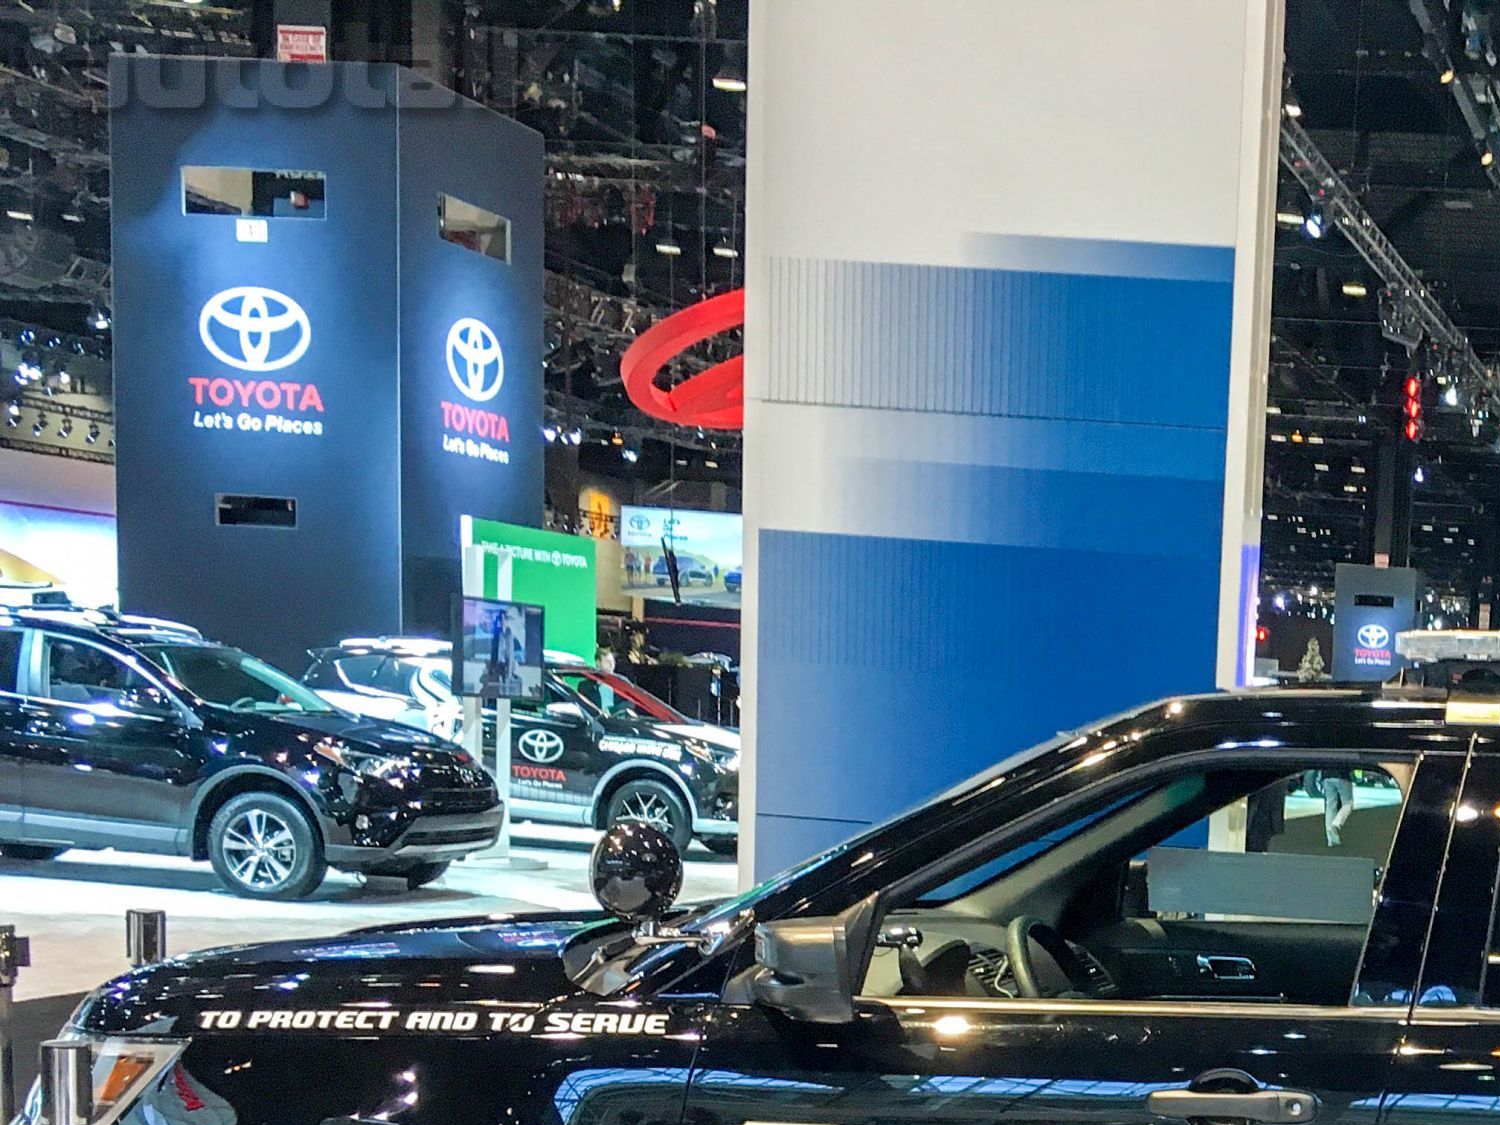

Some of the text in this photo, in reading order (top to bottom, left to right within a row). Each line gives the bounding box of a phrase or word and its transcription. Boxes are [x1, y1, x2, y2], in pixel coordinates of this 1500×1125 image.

[188, 377, 325, 412] TOYOTA
[193, 410, 323, 436] Let's Go Places
[441, 400, 510, 445] TOYOTA
[443, 433, 509, 465] Let's Go Places
[534, 550, 551, 563] WITH
[562, 553, 588, 569] TOYOTA
[1353, 648, 1392, 659] TOYOTA
[512, 765, 566, 781] TOYOTA
[542, 781, 563, 789] Places
[200, 1011, 242, 1029] TO
[247, 1010, 400, 1030] PROTECT
[405, 1011, 478, 1031] AND
[489, 1012, 535, 1032] TO
